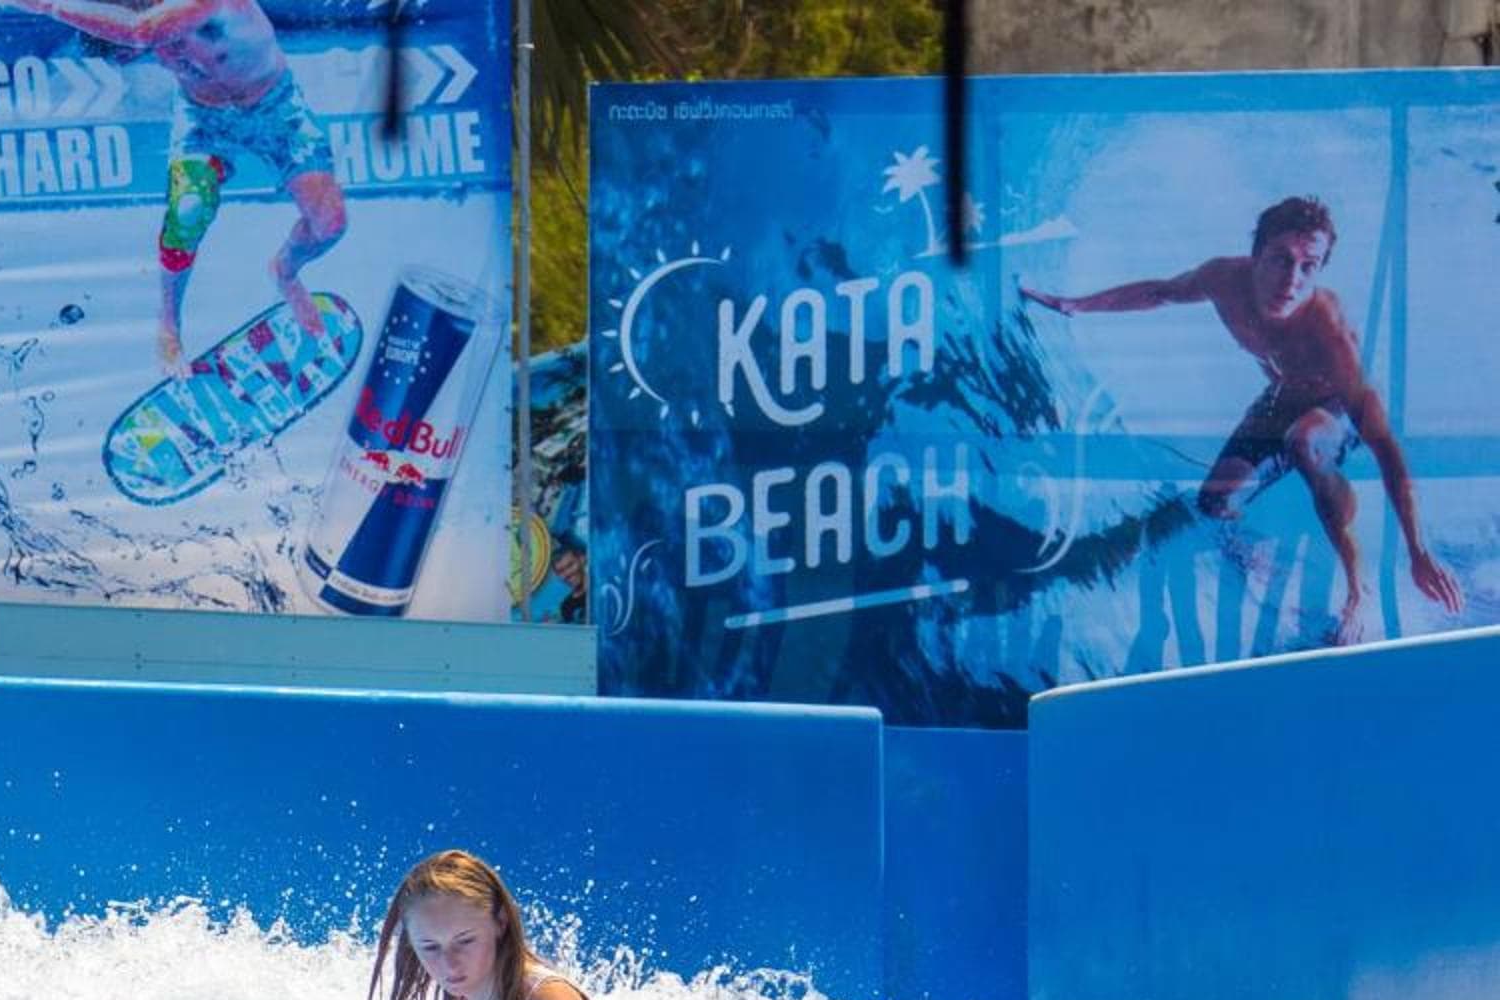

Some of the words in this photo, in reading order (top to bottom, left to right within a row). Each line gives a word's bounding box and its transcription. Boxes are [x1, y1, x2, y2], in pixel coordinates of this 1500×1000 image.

[329, 112, 485, 185] HOME
[717, 271, 937, 427] KATA
[409, 420, 465, 459] Bull
[685, 443, 970, 588] BEACH
